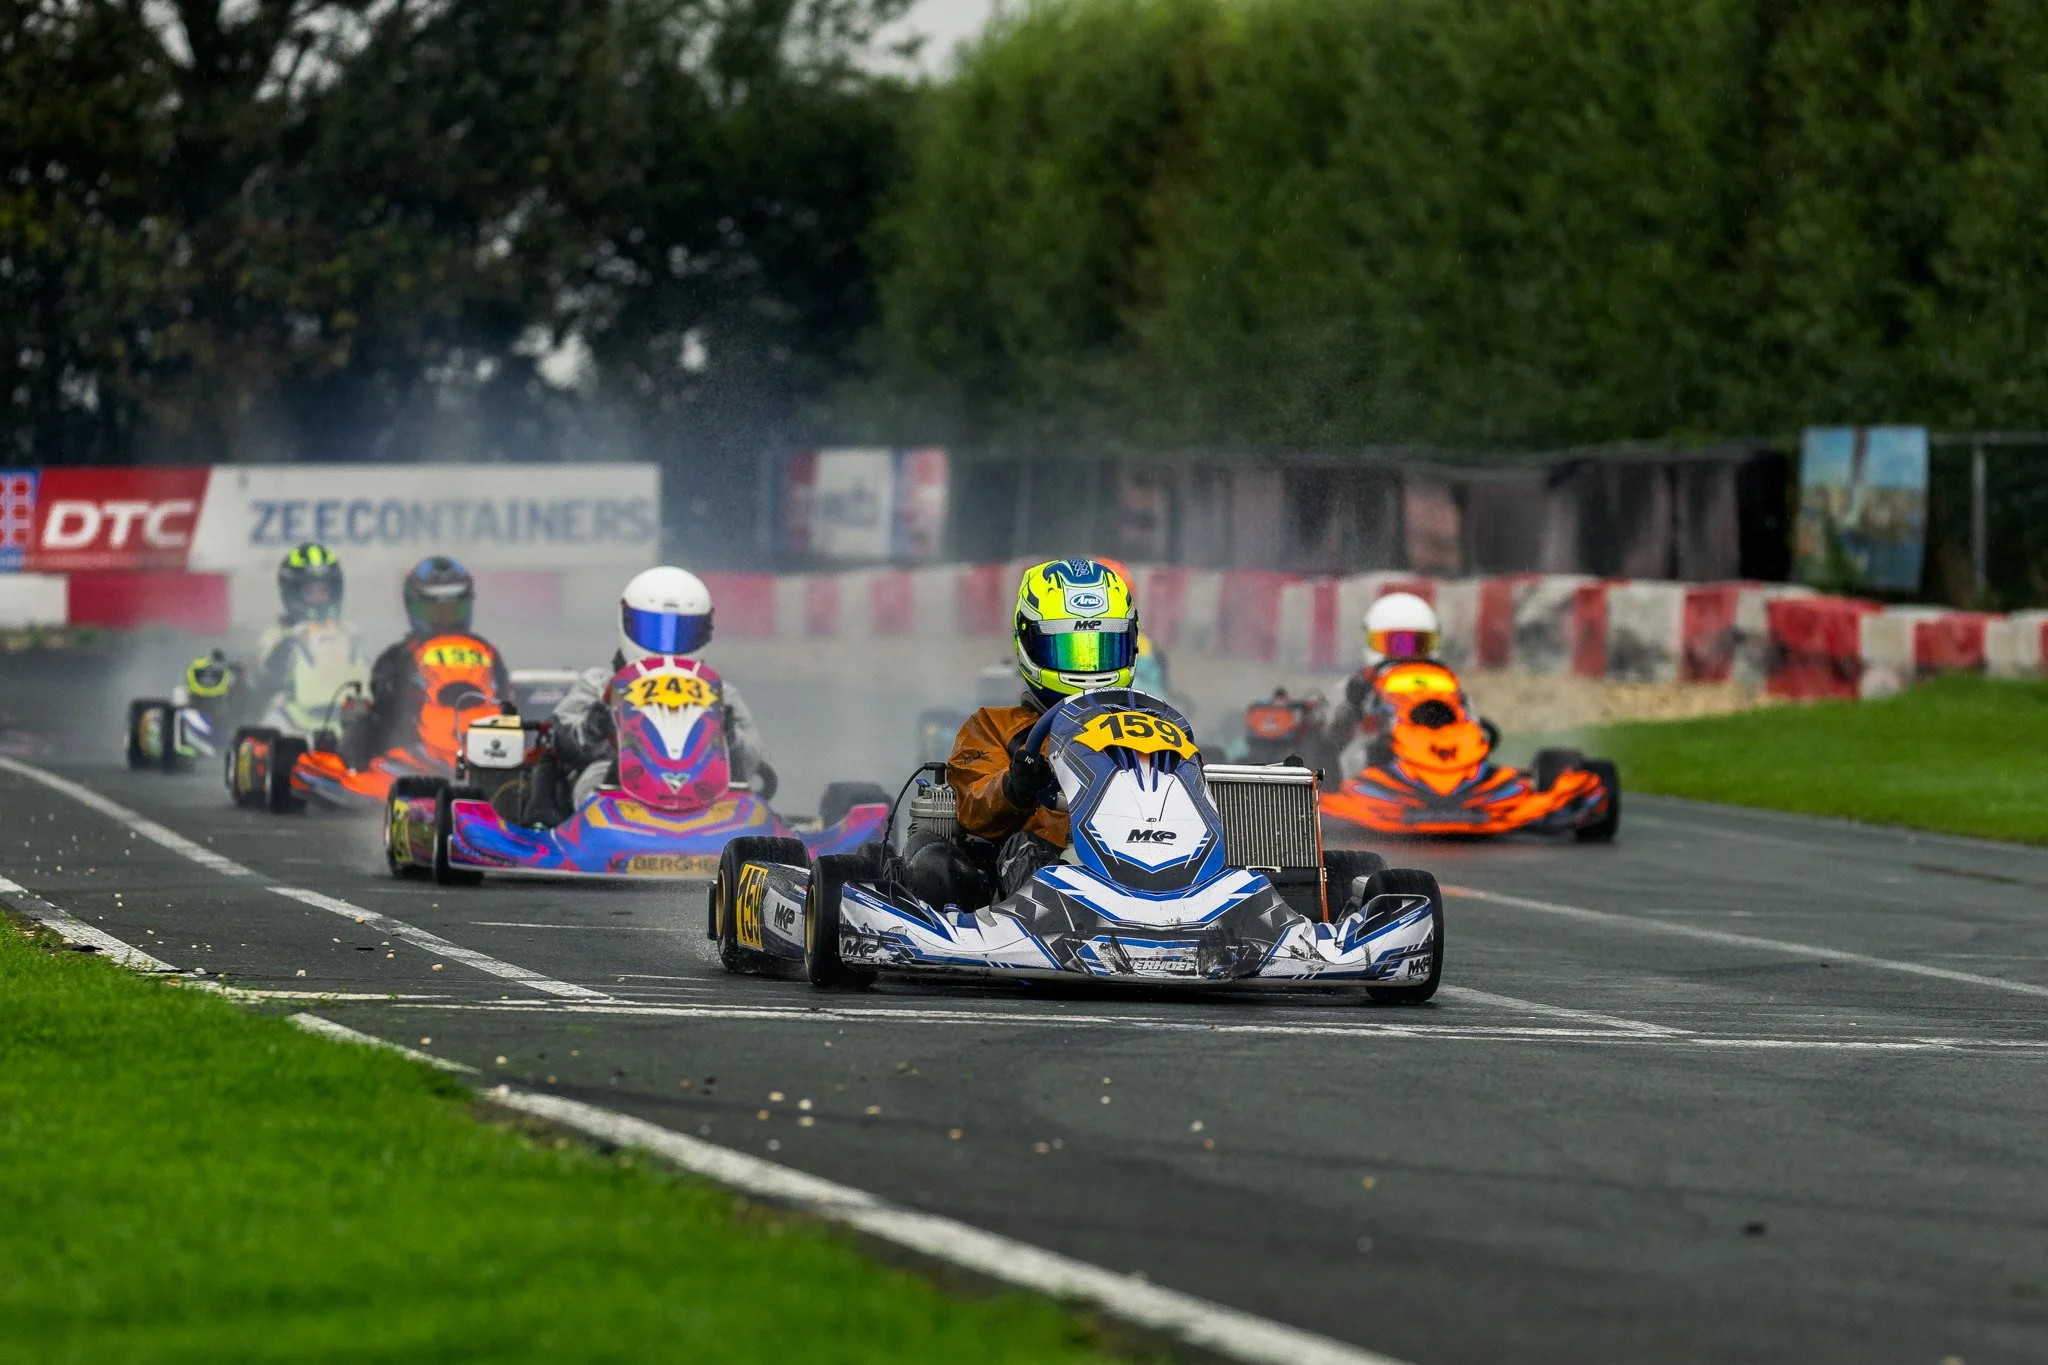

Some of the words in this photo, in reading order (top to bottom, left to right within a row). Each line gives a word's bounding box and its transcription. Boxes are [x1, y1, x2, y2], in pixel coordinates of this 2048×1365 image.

[43, 499, 194, 549] DTC
[250, 499, 655, 545] ZEECONTAINERS
[1076, 594, 1100, 605] Arai
[640, 677, 703, 699] 243
[1098, 714, 1183, 748] 159
[1126, 829, 1177, 843] MKP
[738, 867, 765, 945] 159
